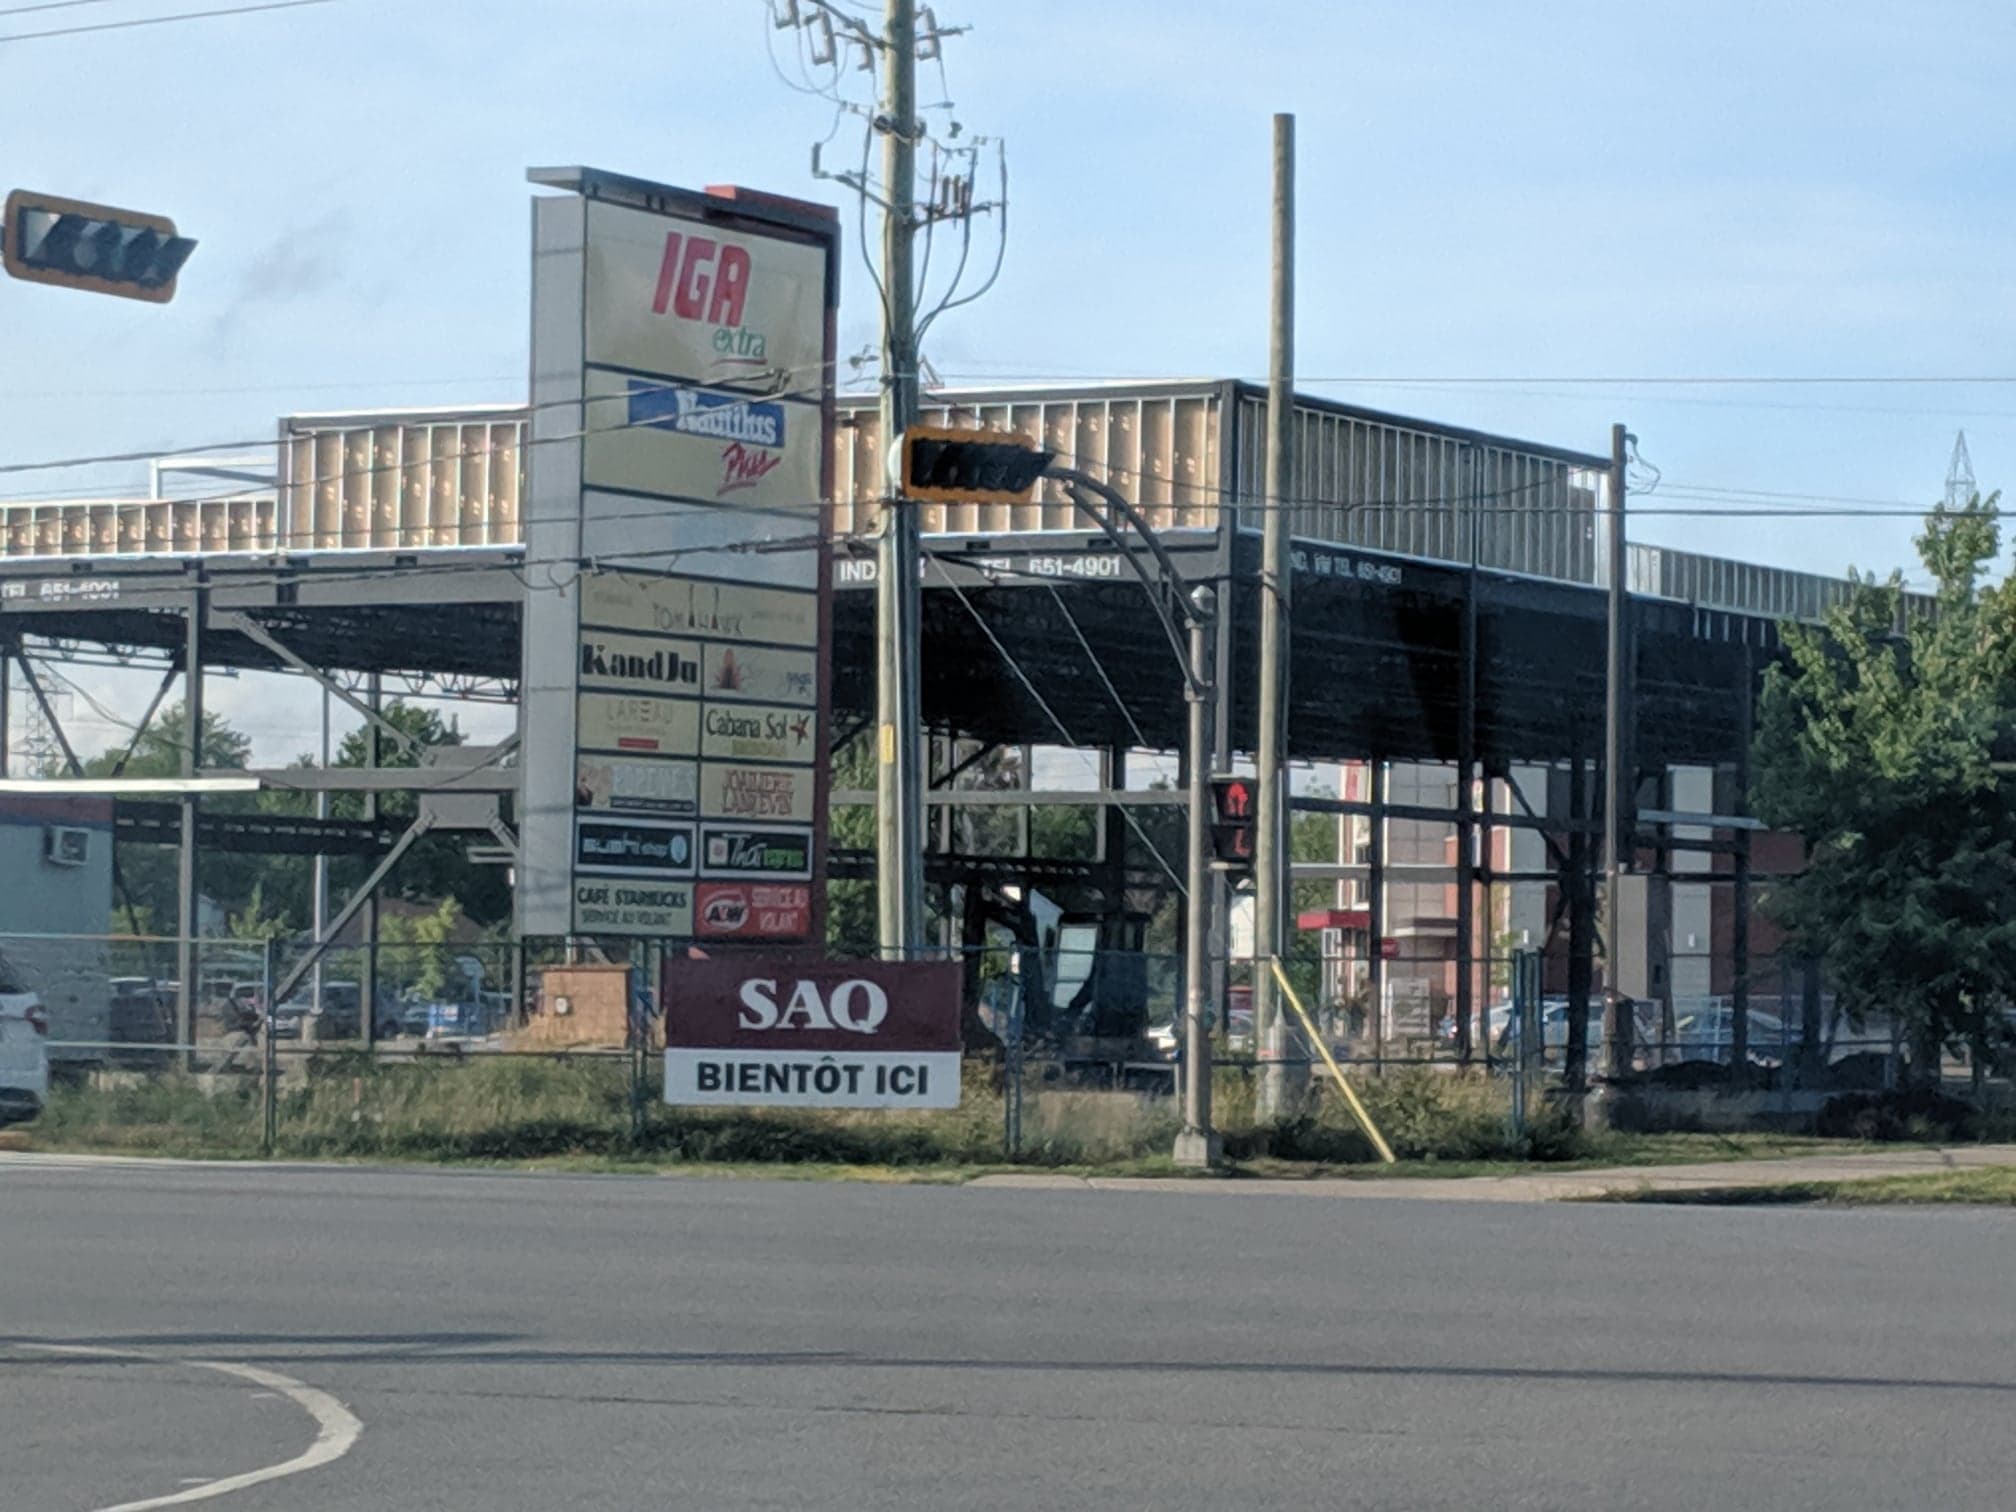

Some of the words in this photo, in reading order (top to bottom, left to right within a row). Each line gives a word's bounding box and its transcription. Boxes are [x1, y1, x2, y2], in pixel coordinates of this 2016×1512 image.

[651, 230, 753, 328] IGA
[712, 327, 768, 359] extra
[706, 708, 761, 739] Cabana
[764, 712, 788, 740] Sol
[615, 889, 688, 909] STARBUCKS
[738, 978, 889, 1035] SAQ
[697, 1055, 864, 1095] BIENTÔT
[875, 1064, 929, 1096] ICI
